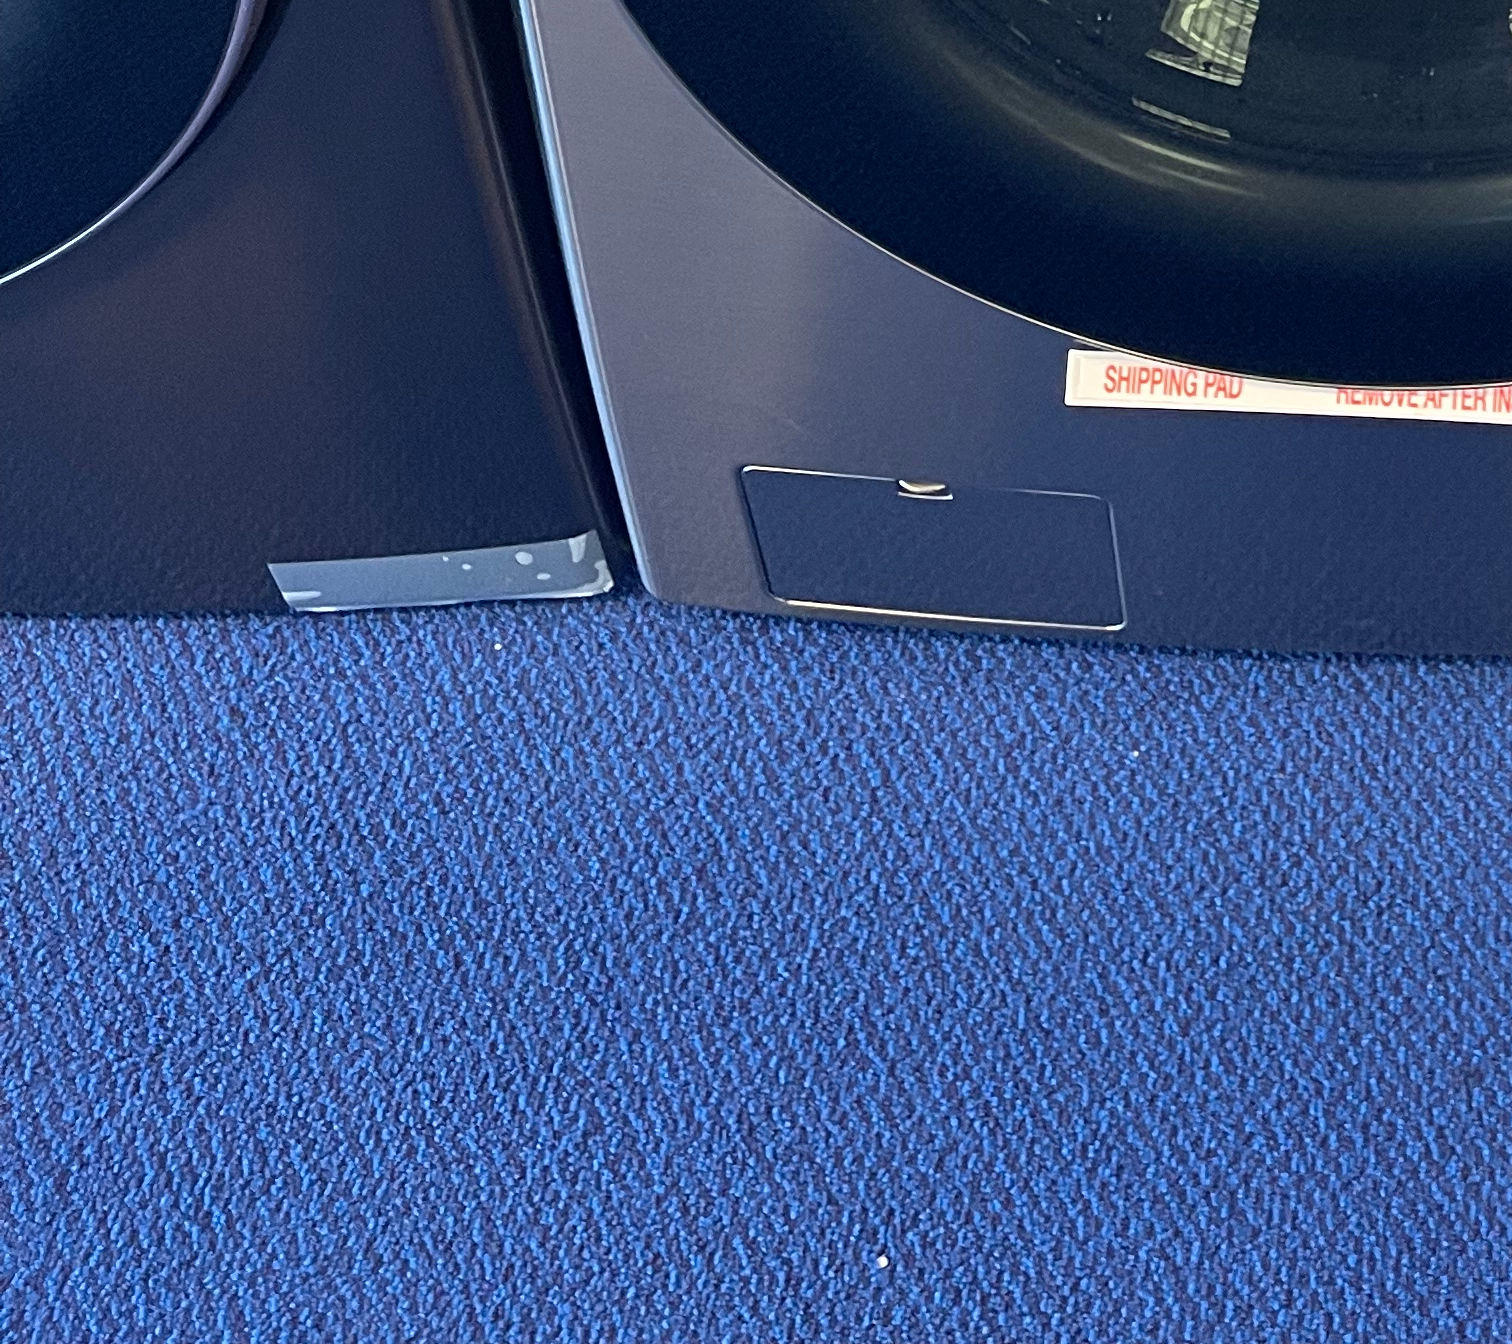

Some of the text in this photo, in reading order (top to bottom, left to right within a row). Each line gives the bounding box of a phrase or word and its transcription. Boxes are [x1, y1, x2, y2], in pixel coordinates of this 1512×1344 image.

[1103, 363, 1198, 398] SHIPPING
[1203, 372, 1245, 400] PAD
[1335, 387, 1419, 408] REMOVE
[1424, 387, 1487, 412] AFTER
